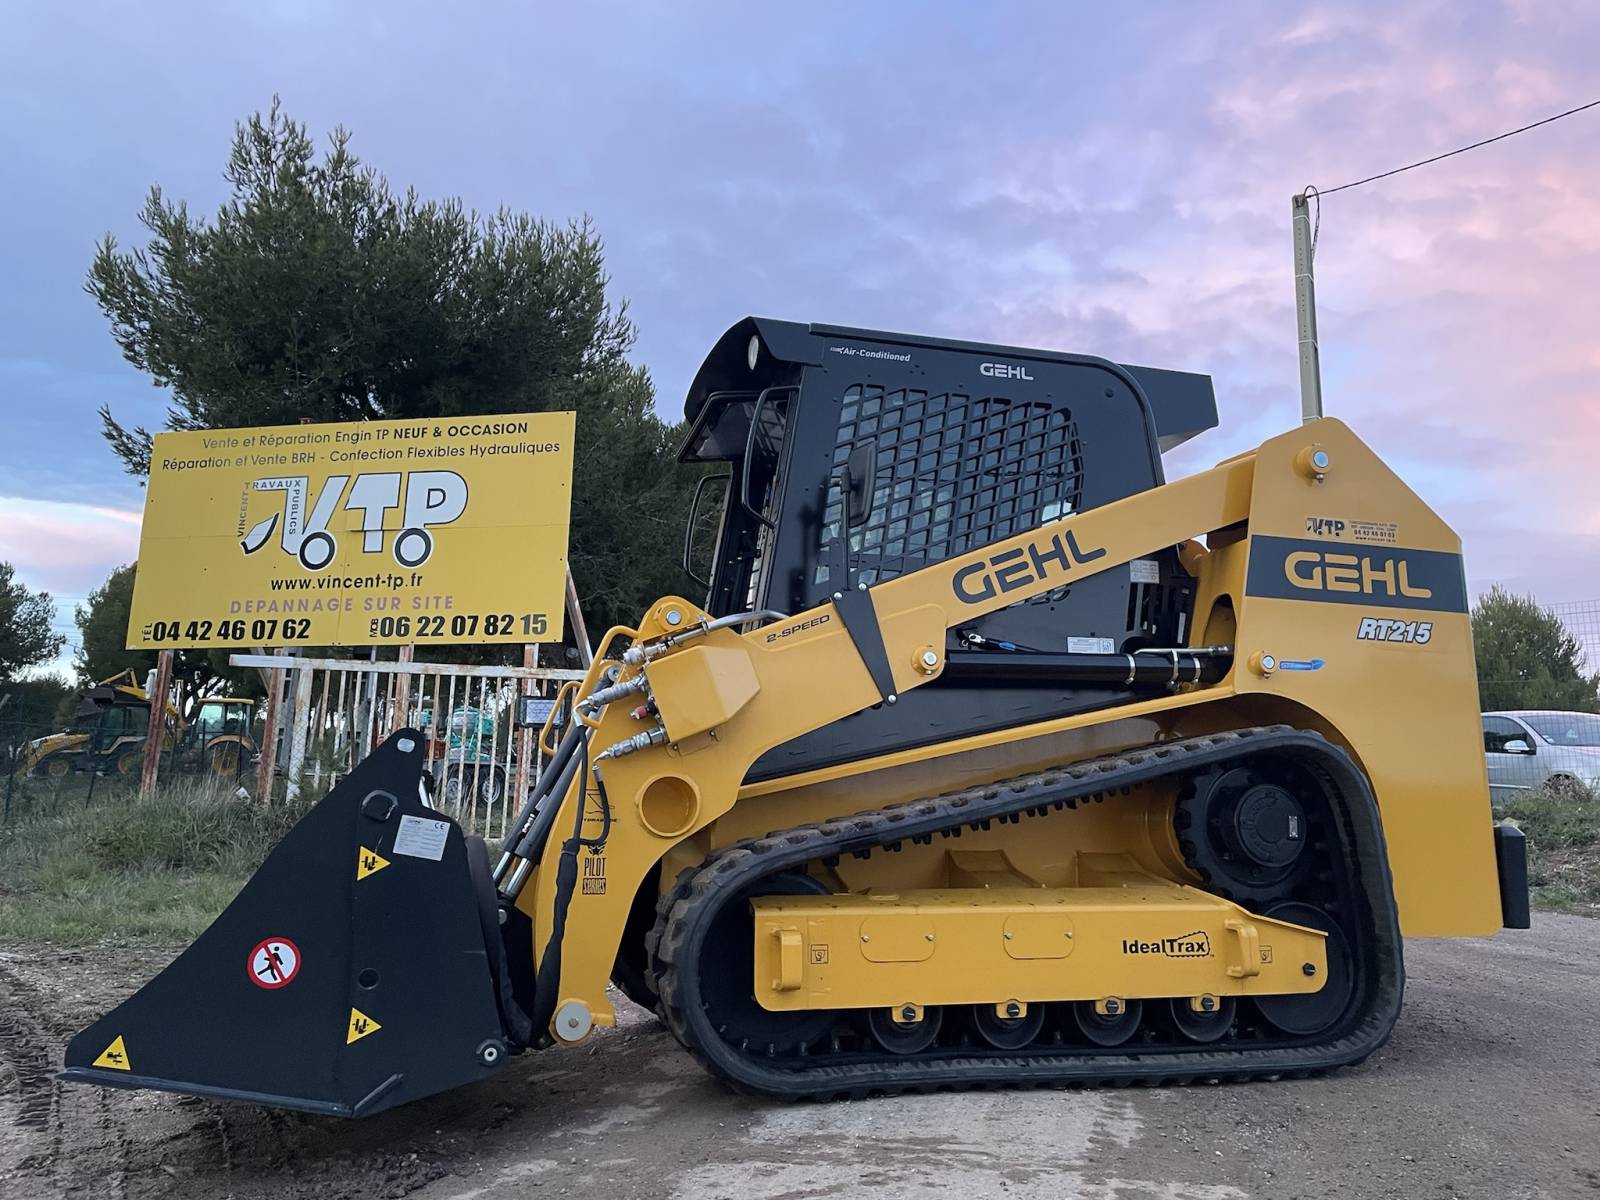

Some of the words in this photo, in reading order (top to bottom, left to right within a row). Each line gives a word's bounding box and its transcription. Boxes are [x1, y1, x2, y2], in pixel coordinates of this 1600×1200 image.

[843, 347, 911, 362] Air-Conditioned
[979, 362, 1034, 381] GEHL
[203, 437, 238, 449] Vente
[243, 436, 256, 447] et
[259, 432, 330, 449] Réparation
[335, 431, 371, 445] Engin
[376, 429, 389, 440] TP
[393, 427, 428, 439] NEUF
[433, 426, 442, 438] &
[447, 422, 528, 437] OCCASION
[162, 456, 231, 472] Réparation
[235, 455, 249, 467] et
[251, 453, 287, 466] Vente
[291, 452, 315, 464] BRH
[330, 447, 403, 463] Confection
[407, 444, 465, 458] Flexibles
[470, 442, 561, 458] Hydrauliques
[243, 480, 300, 489] TRAVAUX
[237, 492, 250, 538] VINCENT
[288, 489, 300, 535] PUBLICS
[953, 529, 1107, 605] GEHL
[1284, 551, 1432, 598] GEHL
[271, 572, 423, 591] www.vincent-tp.fr
[230, 598, 353, 614] DEPANNAGE
[364, 597, 400, 612] SUR
[412, 596, 453, 610] SITE
[152, 621, 180, 642] 04
[185, 620, 213, 641] 42
[216, 620, 246, 641] 46
[251, 619, 278, 640] 07
[282, 618, 311, 640] 62
[380, 616, 411, 638] 06
[415, 616, 446, 637] 22
[451, 615, 479, 636] 07
[484, 614, 514, 636] 82
[520, 614, 547, 635] 15
[766, 614, 830, 643] 2-SPEED
[1356, 617, 1432, 644] RT215
[584, 857, 606, 876] PILOT
[1122, 939, 1206, 954] IdealTrax
